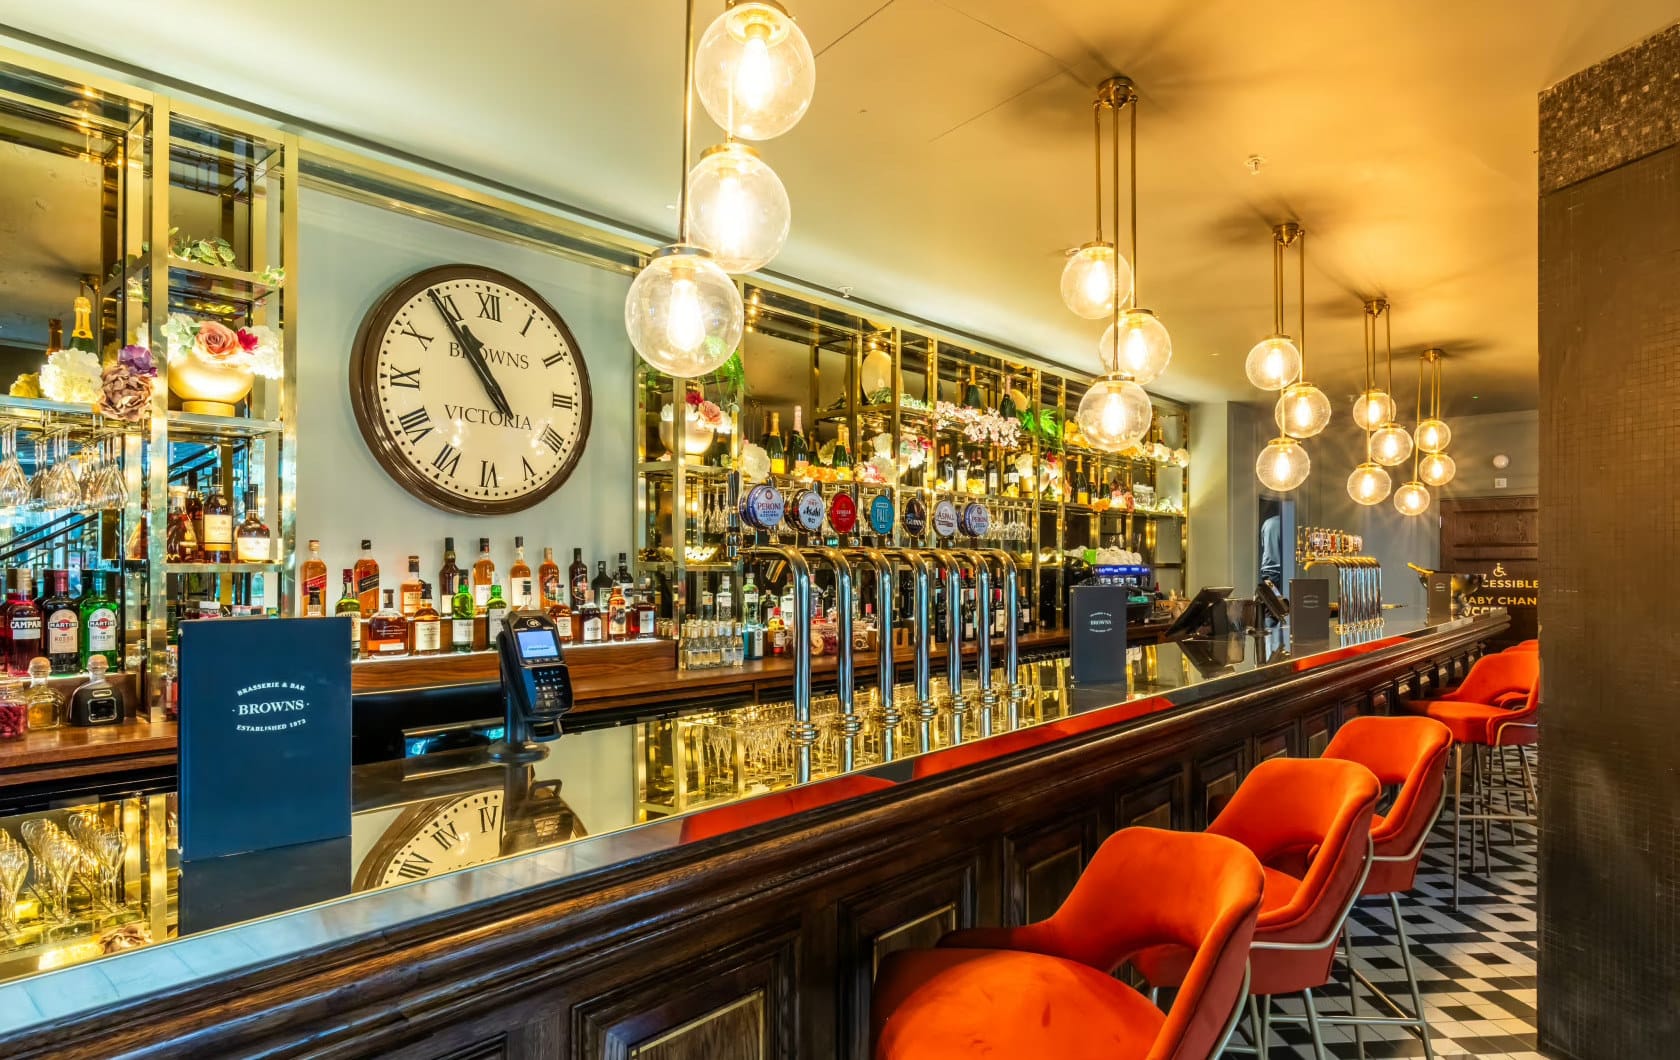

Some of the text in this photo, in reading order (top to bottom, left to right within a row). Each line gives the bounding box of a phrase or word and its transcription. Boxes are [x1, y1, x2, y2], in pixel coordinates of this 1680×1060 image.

[475, 292, 503, 323] XII
[449, 342, 529, 369] BWNS
[445, 404, 532, 430] VICTORIA
[757, 502, 781, 510] PERONI
[803, 506, 820, 517] Asahi
[1482, 580, 1539, 588] CESSIBLE
[1464, 597, 1537, 605] ABY CHAN
[237, 682, 280, 696] BRASSERIE
[290, 682, 305, 691] BAR
[238, 699, 304, 715] BROWNS
[236, 718, 306, 732] ESTABLISHED 1973
